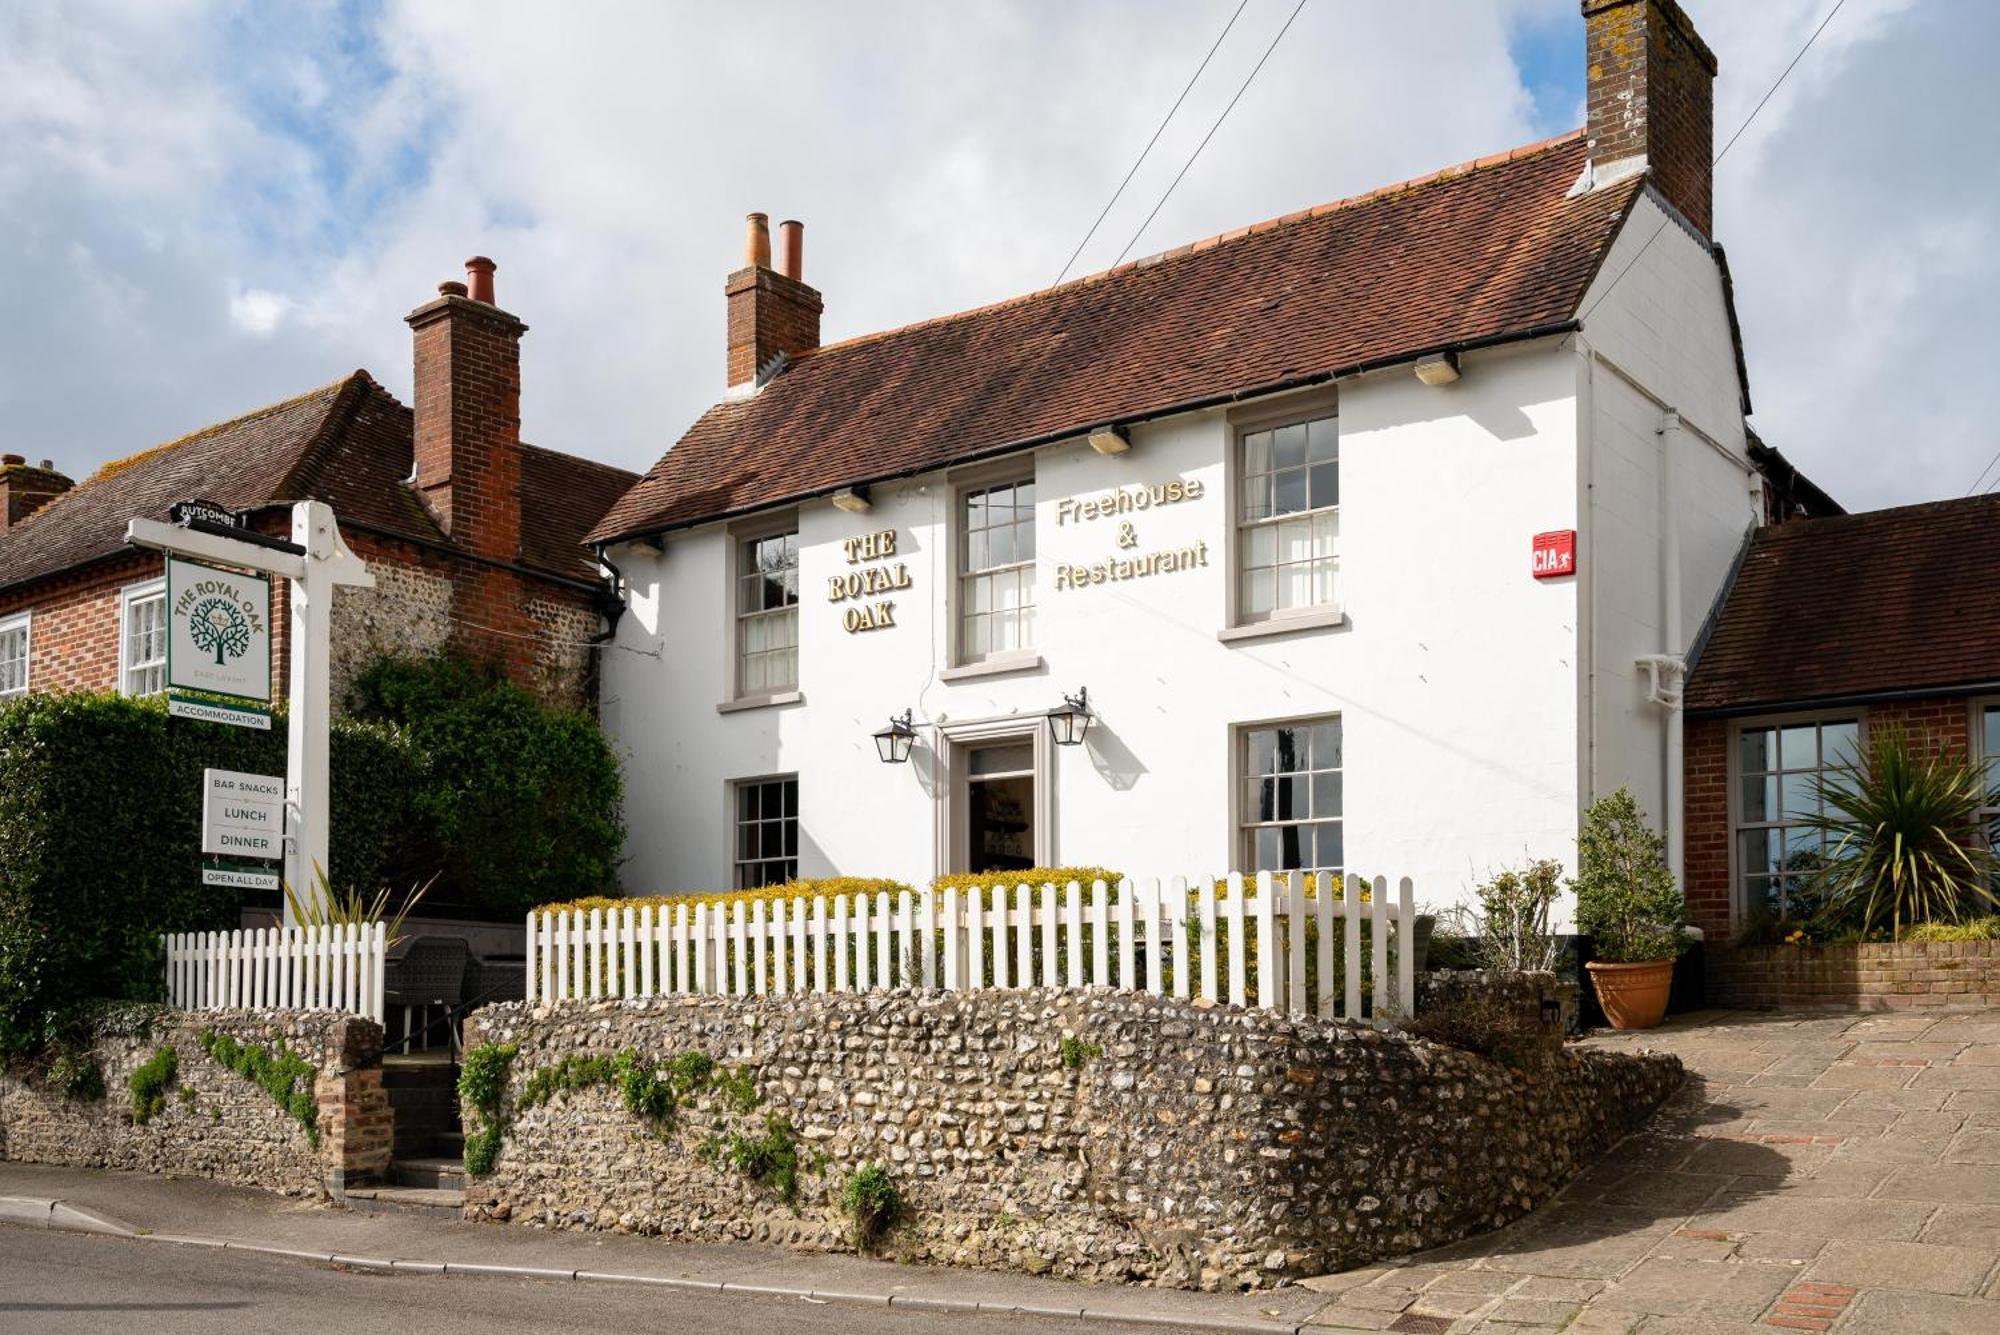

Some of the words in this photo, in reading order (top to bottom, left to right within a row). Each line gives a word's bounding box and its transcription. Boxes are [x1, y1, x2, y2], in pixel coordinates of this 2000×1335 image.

[1055, 479, 1204, 526] Freehouse
[844, 529, 896, 563] THE
[1117, 520, 1137, 549] &
[1055, 539, 1208, 592] Restaurant
[1532, 549, 1557, 571] CIA
[828, 563, 912, 602] ROYAL
[174, 588, 197, 617] THE
[195, 580, 240, 603] ROYAL
[242, 601, 264, 635] OAK
[843, 600, 896, 633] OAK
[176, 705, 264, 726] ACCOMMODATION
[214, 779, 235, 789] BAR
[239, 782, 279, 795] SNACKS
[224, 807, 267, 821] LUNCH
[220, 835, 269, 849] DINNER
[207, 872, 234, 884] OPEN
[236, 875, 254, 885] ALL
[255, 876, 274, 887] DAY
